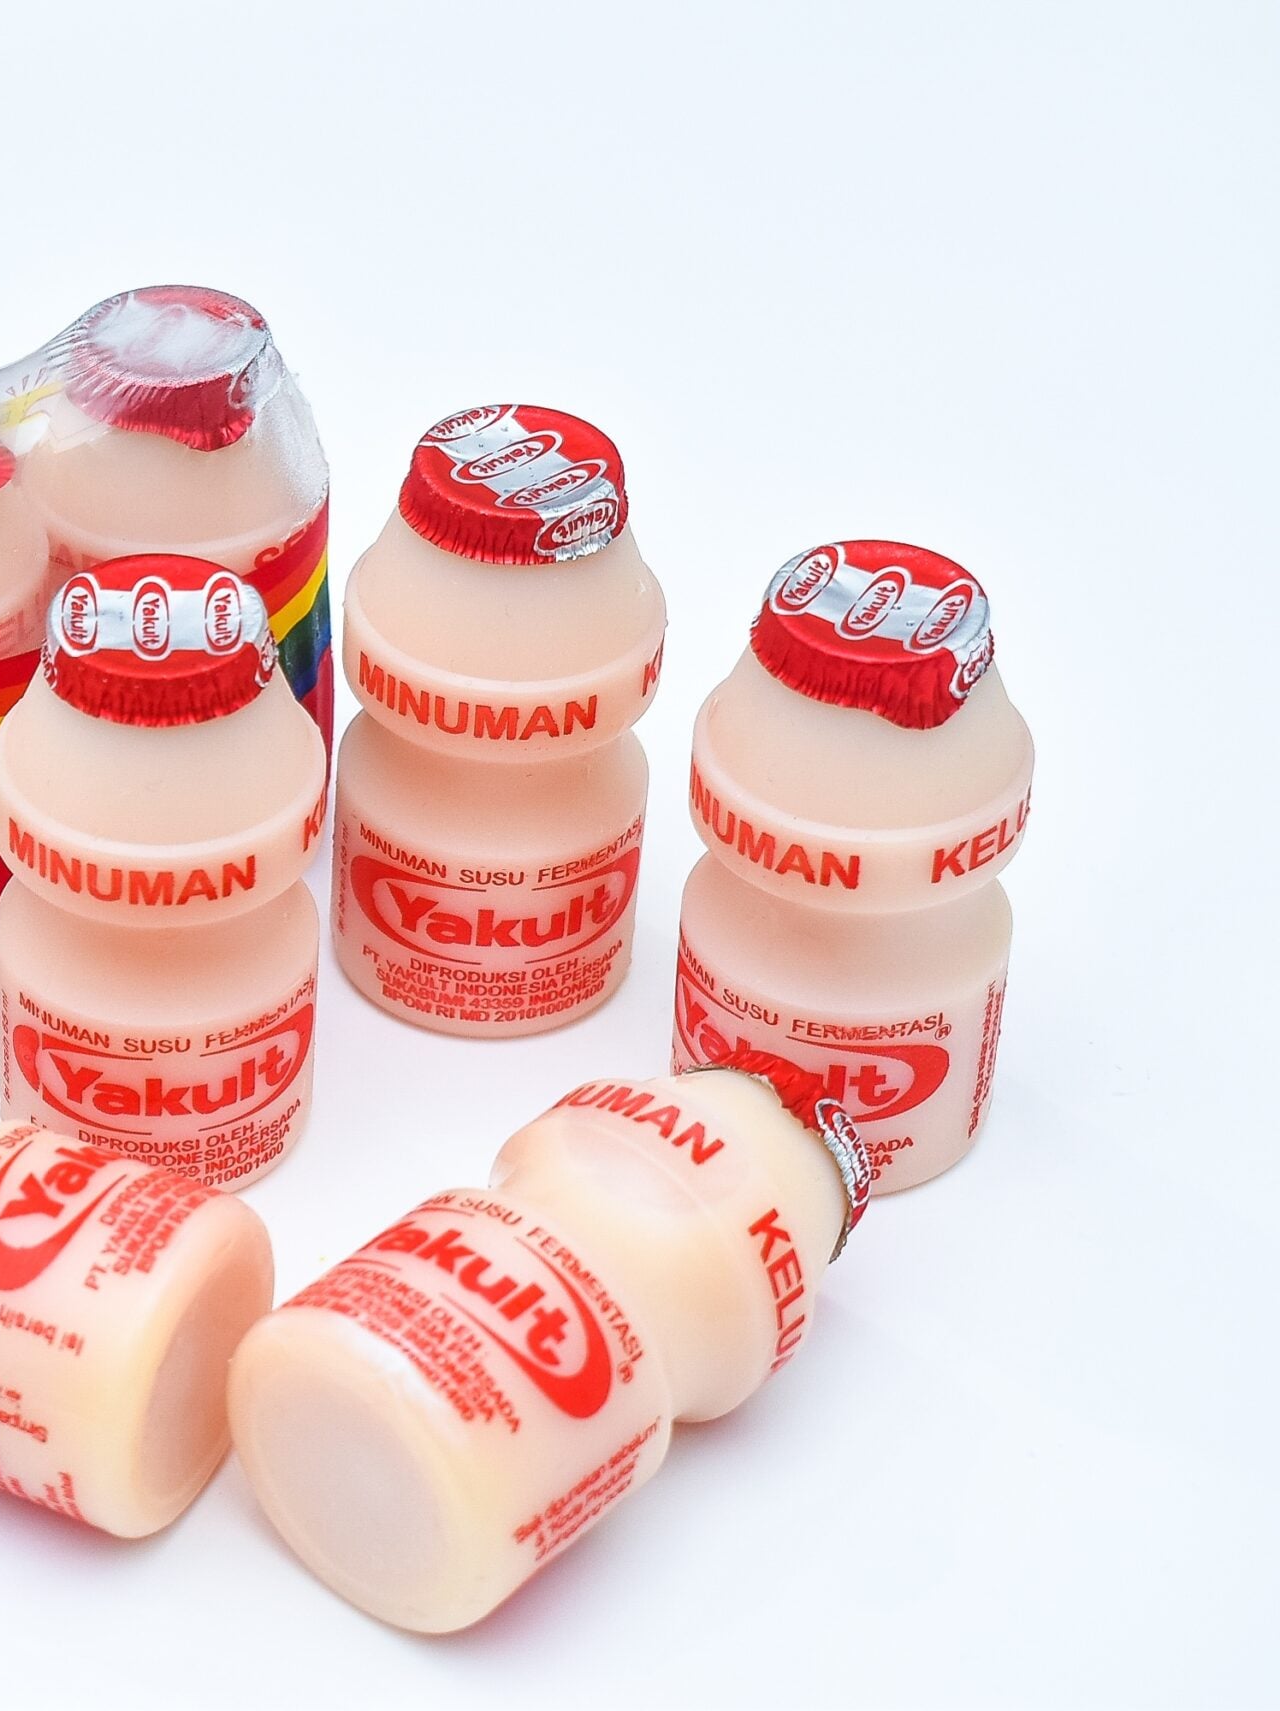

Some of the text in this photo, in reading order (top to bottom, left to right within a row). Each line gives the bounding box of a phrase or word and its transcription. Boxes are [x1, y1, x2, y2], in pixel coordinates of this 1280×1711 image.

[431, 406, 499, 437] Yakult
[471, 440, 542, 476] Yakult
[513, 468, 591, 505] Yakult
[784, 558, 831, 603] Yakult
[70, 593, 89, 642] Yakult
[141, 596, 161, 647] Yakult
[214, 592, 233, 645] Yakult
[850, 585, 898, 629] Yakult
[919, 598, 965, 642] Yakult
[359, 650, 598, 741] MINUMAN
[690, 760, 861, 890] INUMAN
[8, 816, 257, 907] MINUMAN
[360, 822, 447, 879] MINUMAN
[458, 868, 526, 887] SUSU
[386, 881, 618, 948] Yakult
[362, 939, 623, 998] PT. YAKULT INDONESIA PERSADA
[409, 957, 527, 984] DIPRODUKSI
[531, 957, 579, 981] OLEH
[528, 962, 613, 1006] INDONESIA
[722, 988, 779, 1026] SUSU
[791, 1012, 944, 1041] FERMENTASI
[123, 1035, 192, 1055] SUSU
[681, 977, 900, 1106] Yalt
[49, 1044, 293, 1116] Yakult
[78, 1128, 201, 1154] DIPRODUKSI
[206, 1121, 257, 1148] OLEH
[204, 1123, 291, 1175] INDONESIA
[238, 1098, 302, 1150] PERSADA
[553, 1084, 725, 1166] UMAN
[864, 1136, 915, 1155] SADA
[459, 1197, 523, 1227] SUSU
